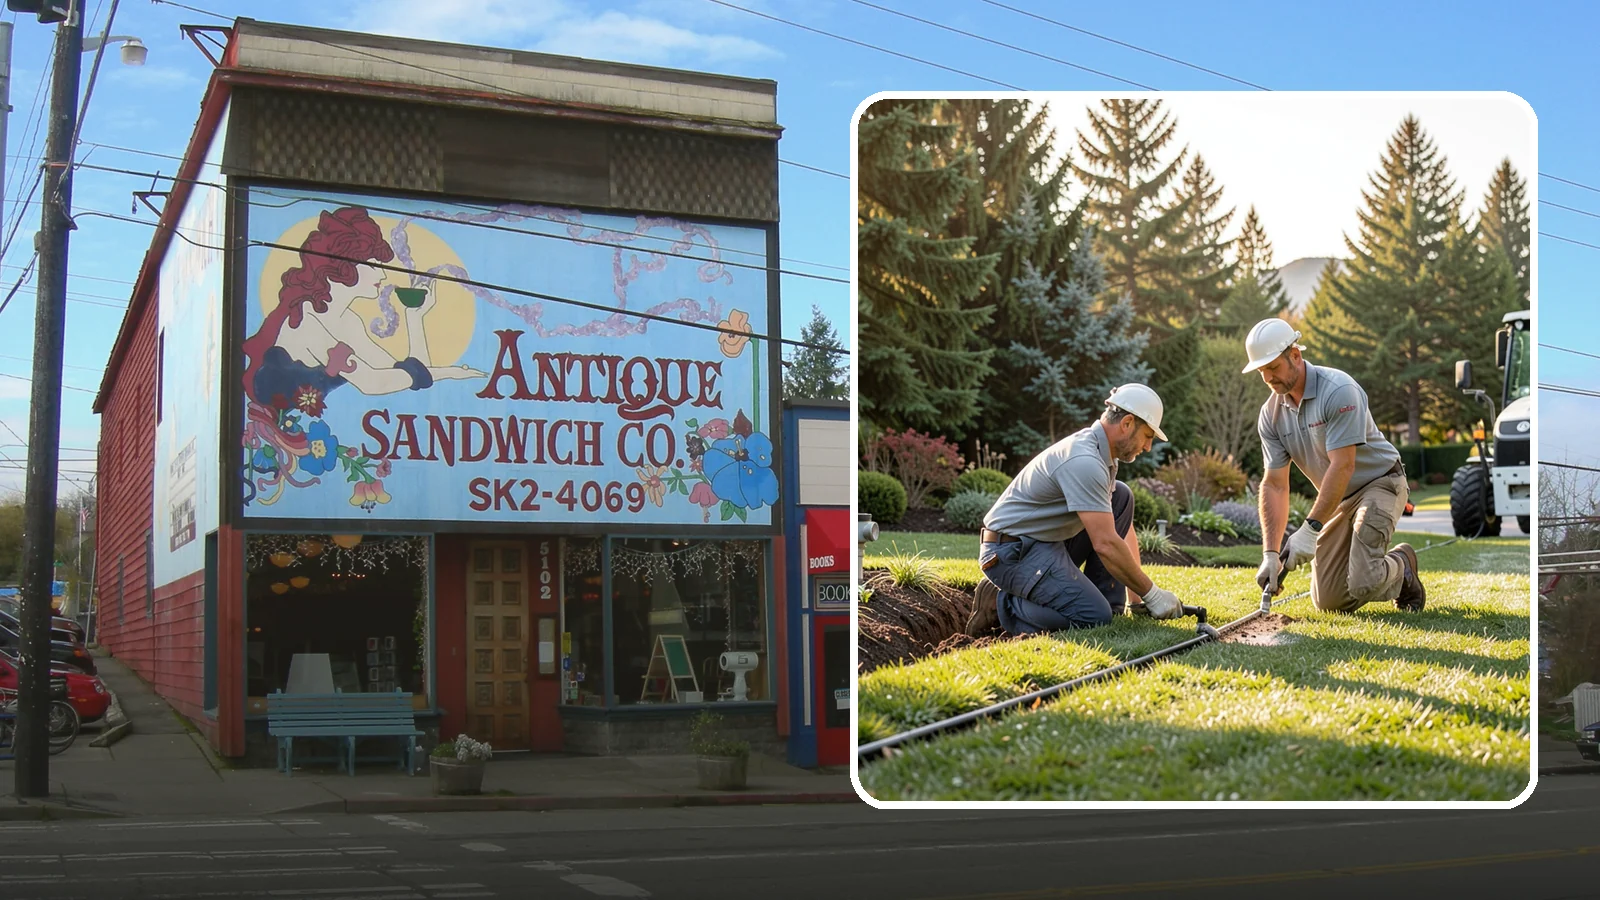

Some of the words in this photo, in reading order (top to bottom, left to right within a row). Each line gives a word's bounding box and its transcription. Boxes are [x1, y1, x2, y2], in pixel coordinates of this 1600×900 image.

[475, 328, 724, 421] ANTIQUE
[361, 408, 604, 467] SANDWICH
[616, 422, 685, 469] CO.
[468, 477, 646, 513] SK2-4069
[539, 541, 552, 600] 5102
[809, 555, 835, 569] BOOKS
